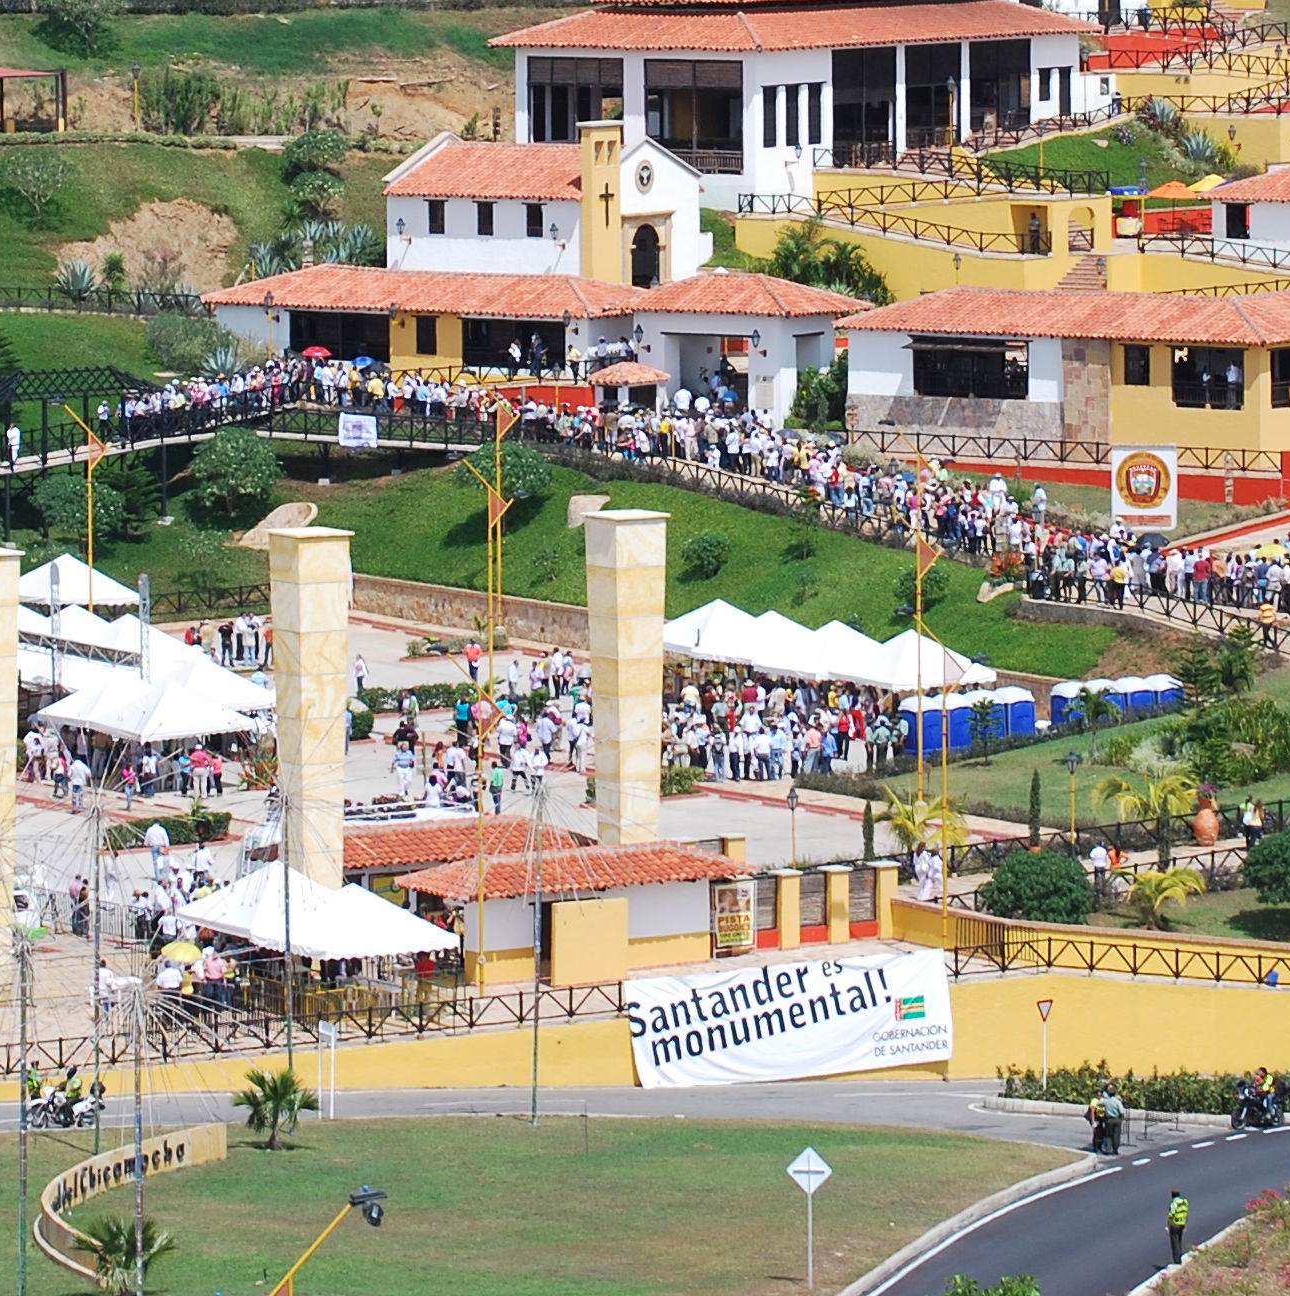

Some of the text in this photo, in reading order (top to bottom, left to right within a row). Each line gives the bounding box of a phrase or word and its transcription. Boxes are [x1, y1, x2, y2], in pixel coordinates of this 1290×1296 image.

[718, 915, 750, 924] PISTA
[628, 958, 843, 1038] Santander es
[651, 968, 892, 1067] monumental!
[874, 1039, 949, 1057] DE SANTANDER
